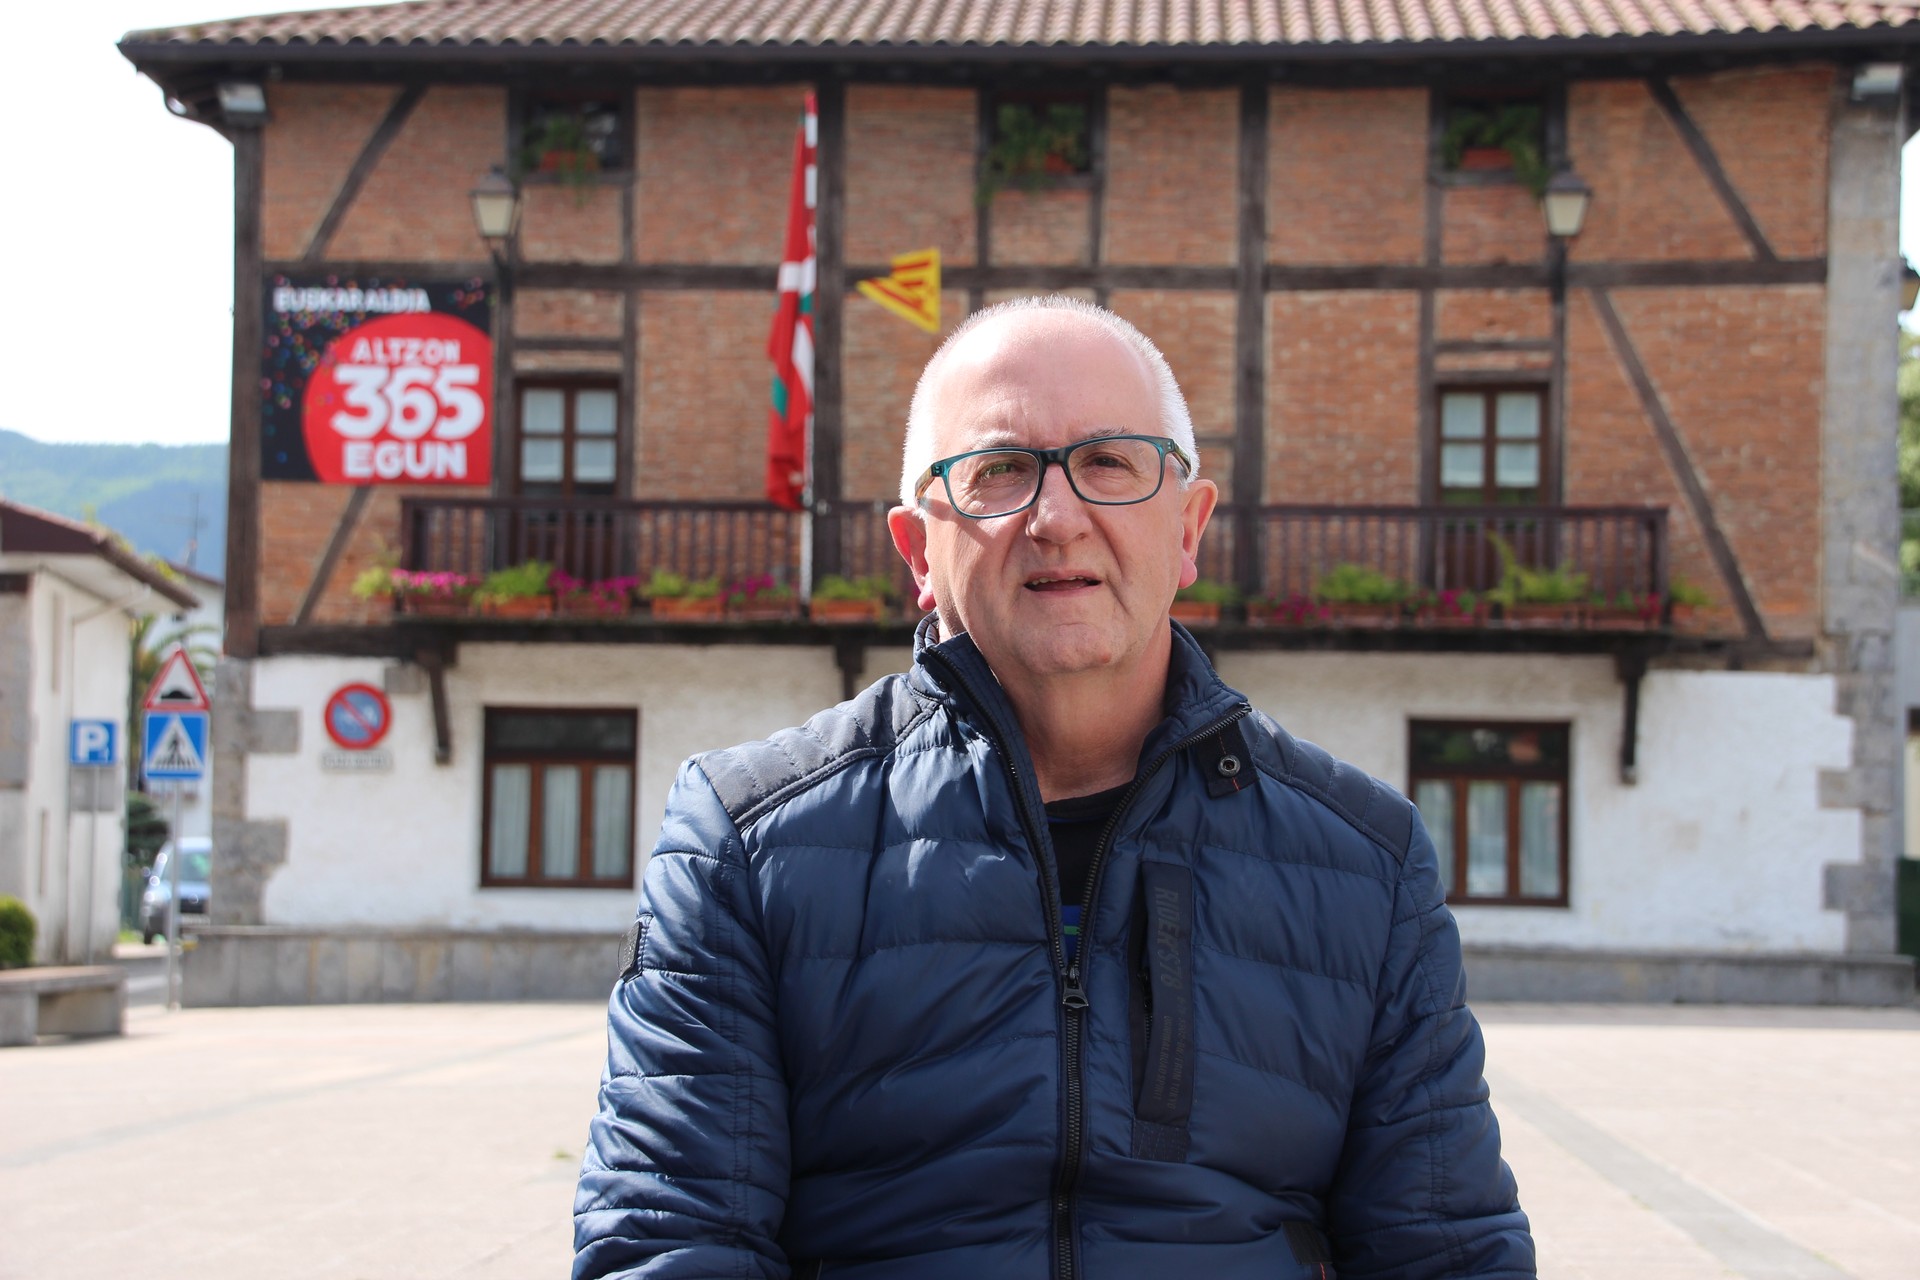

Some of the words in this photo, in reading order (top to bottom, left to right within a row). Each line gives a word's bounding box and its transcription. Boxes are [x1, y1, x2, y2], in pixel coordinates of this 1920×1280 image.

[352, 338, 461, 363] ALTZON
[331, 364, 485, 440] 365
[343, 441, 467, 479] EGUN
[77, 723, 109, 762] P
